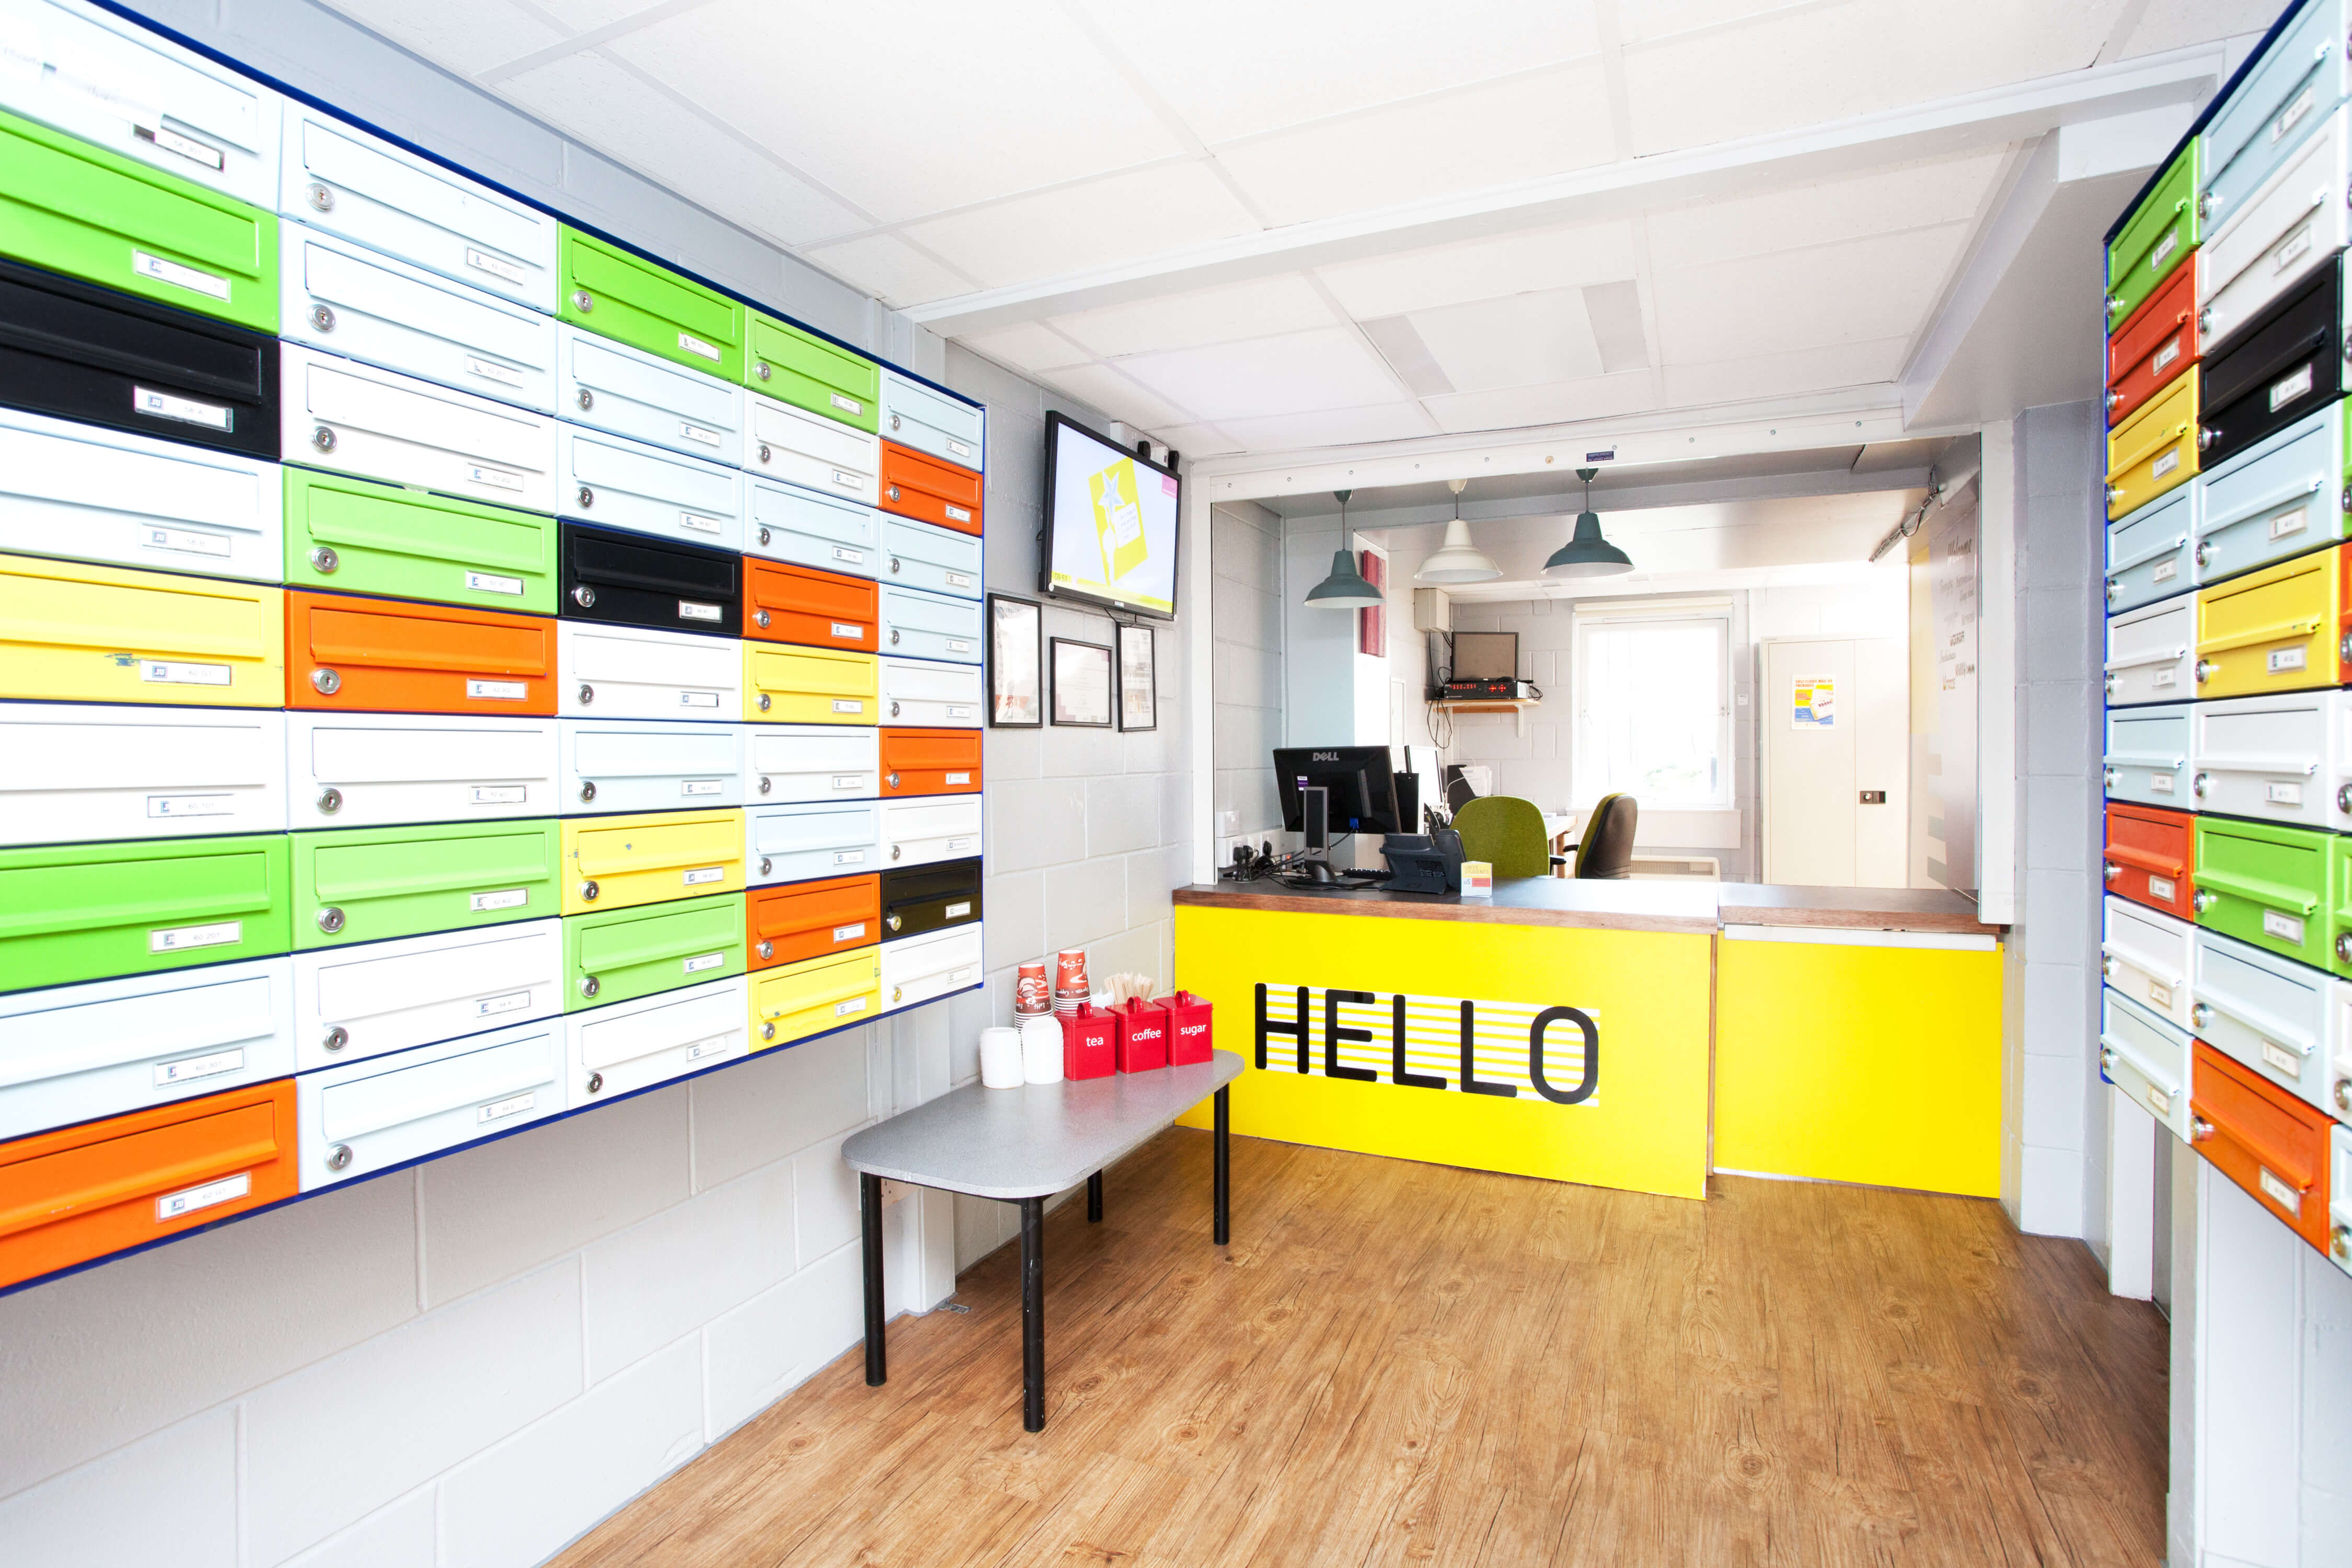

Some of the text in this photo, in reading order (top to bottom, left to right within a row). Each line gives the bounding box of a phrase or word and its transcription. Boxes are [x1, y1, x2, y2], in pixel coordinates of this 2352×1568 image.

[1312, 752, 1339, 761] DELL
[1132, 1029, 1161, 1042] coffee
[1180, 1024, 1206, 1036] sugar
[1086, 1037, 1104, 1047] tea
[1254, 982, 1599, 1105] HELLO
